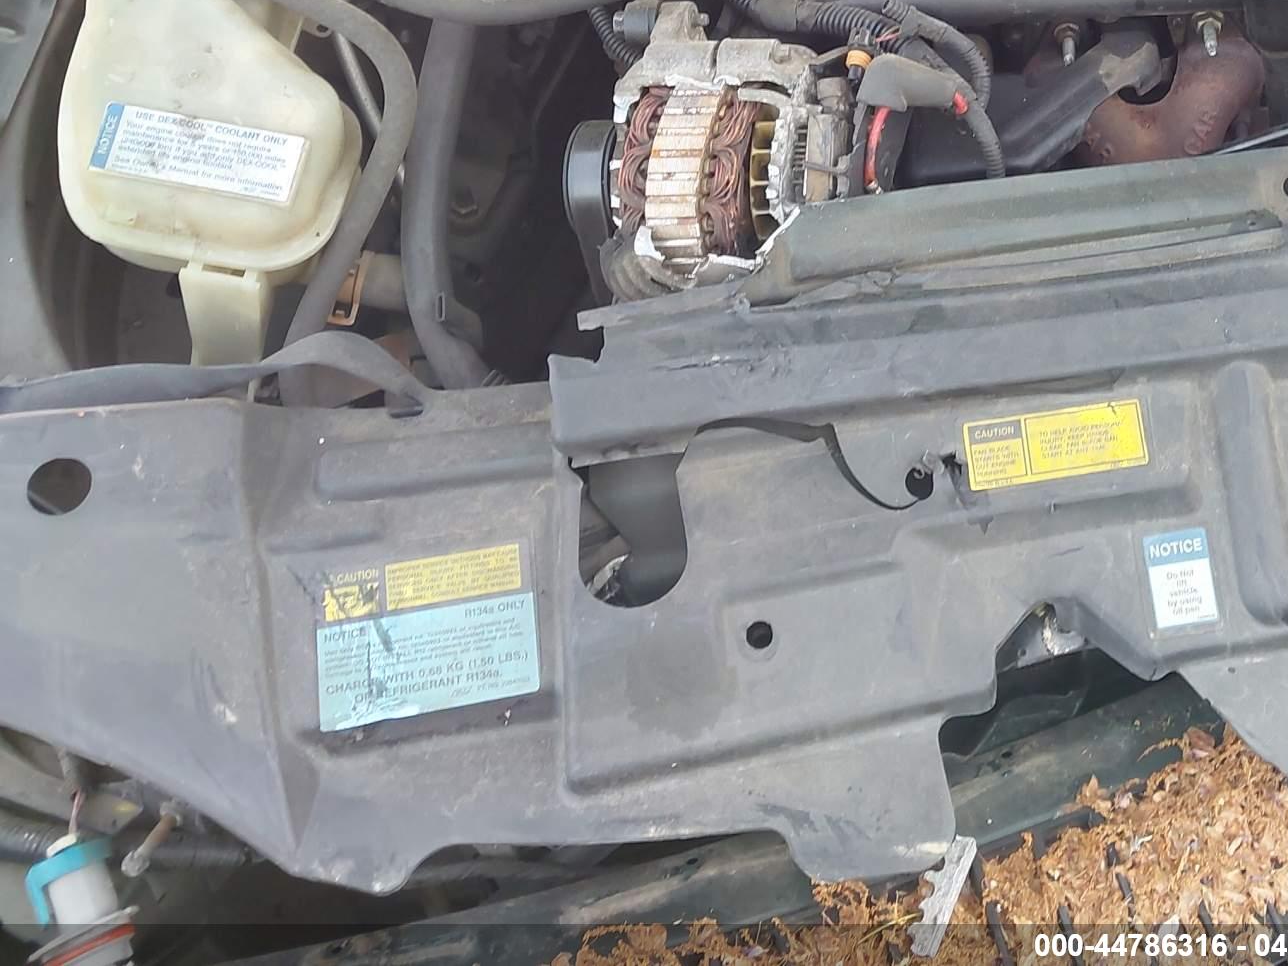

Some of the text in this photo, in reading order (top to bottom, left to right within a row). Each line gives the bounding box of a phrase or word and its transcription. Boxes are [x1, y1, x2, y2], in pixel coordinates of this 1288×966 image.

[98, 113, 119, 155] NOTICE
[135, 110, 156, 121] USE
[215, 124, 261, 141] COOLANT
[263, 134, 289, 147] ONLY
[974, 425, 1015, 440] CAUTION
[1149, 537, 1203, 560] NOTICE
[336, 567, 379, 585] CAUTION
[497, 600, 525, 613] ONLY
[324, 626, 367, 643] NOTICE
[383, 670, 415, 685] WITH
[446, 660, 464, 673] KG
